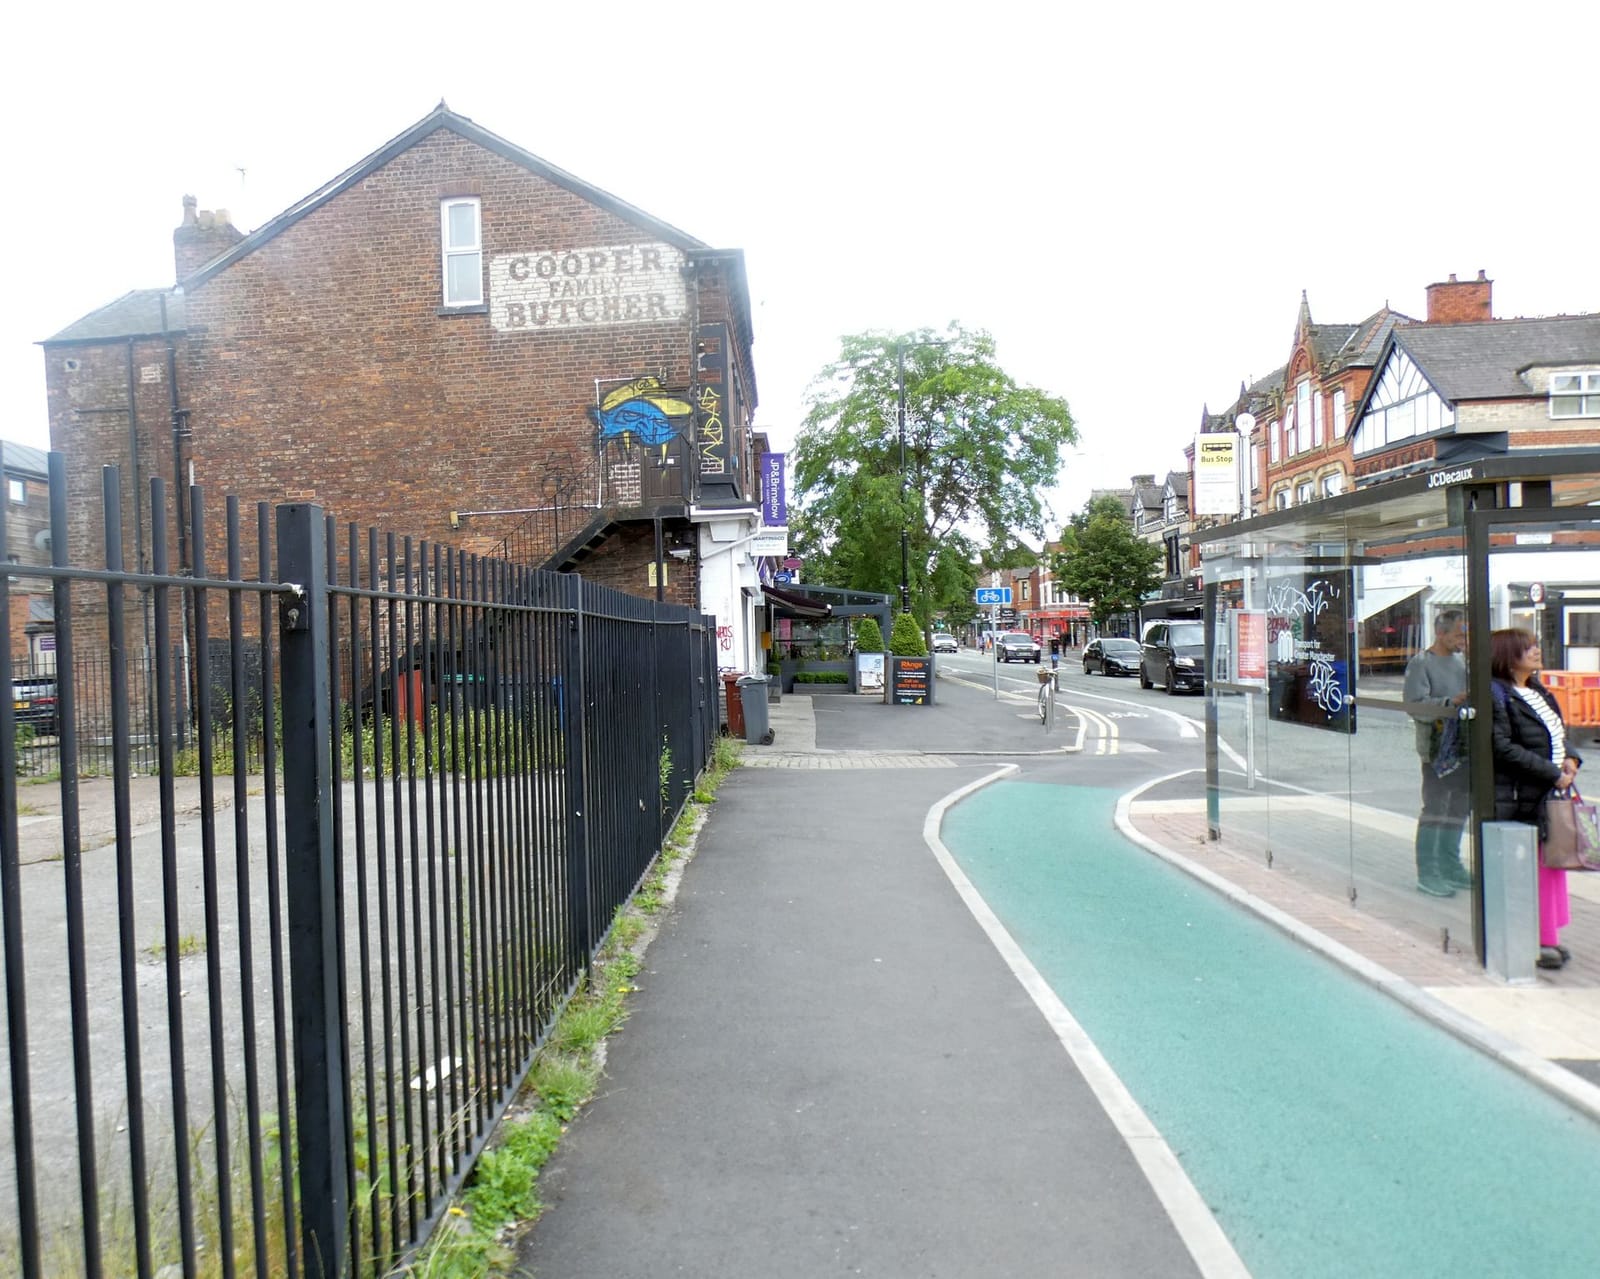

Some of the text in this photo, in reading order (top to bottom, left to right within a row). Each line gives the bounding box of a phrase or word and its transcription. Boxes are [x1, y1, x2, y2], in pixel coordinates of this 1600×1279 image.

[549, 276, 624, 298] FAMILY
[1216, 455, 1233, 463] Stop
[1428, 468, 1473, 488] JCDecaux
